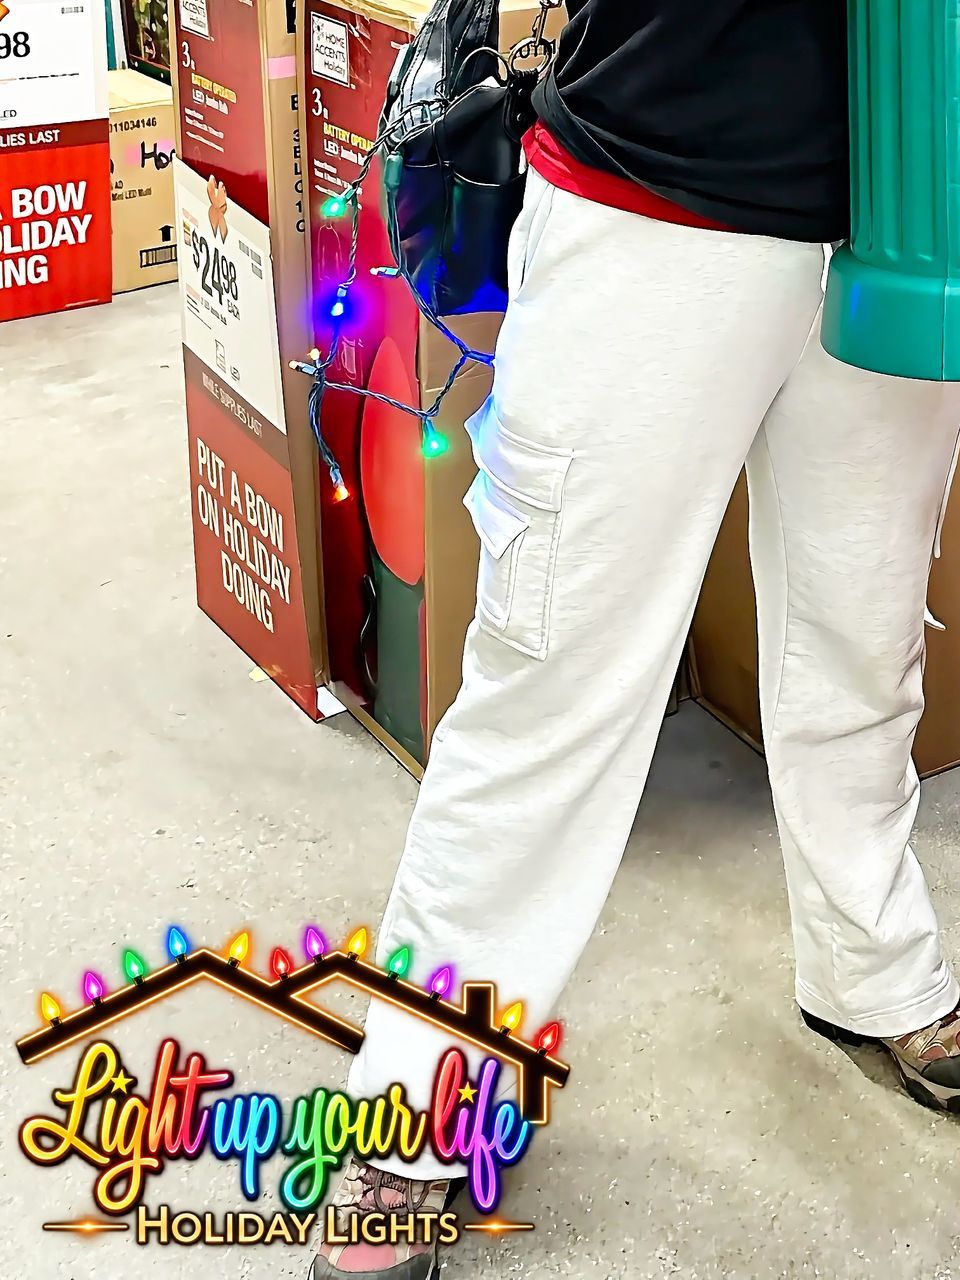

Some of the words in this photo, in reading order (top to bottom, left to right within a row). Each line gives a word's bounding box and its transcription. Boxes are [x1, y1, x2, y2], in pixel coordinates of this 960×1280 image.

[11, 180, 87, 220] BOW
[196, 435, 225, 502] PUT
[230, 482, 243, 522] A
[245, 484, 285, 554] BOW
[197, 484, 221, 542] ON
[222, 518, 292, 605] HOLIDAY
[221, 549, 275, 636] DOING
